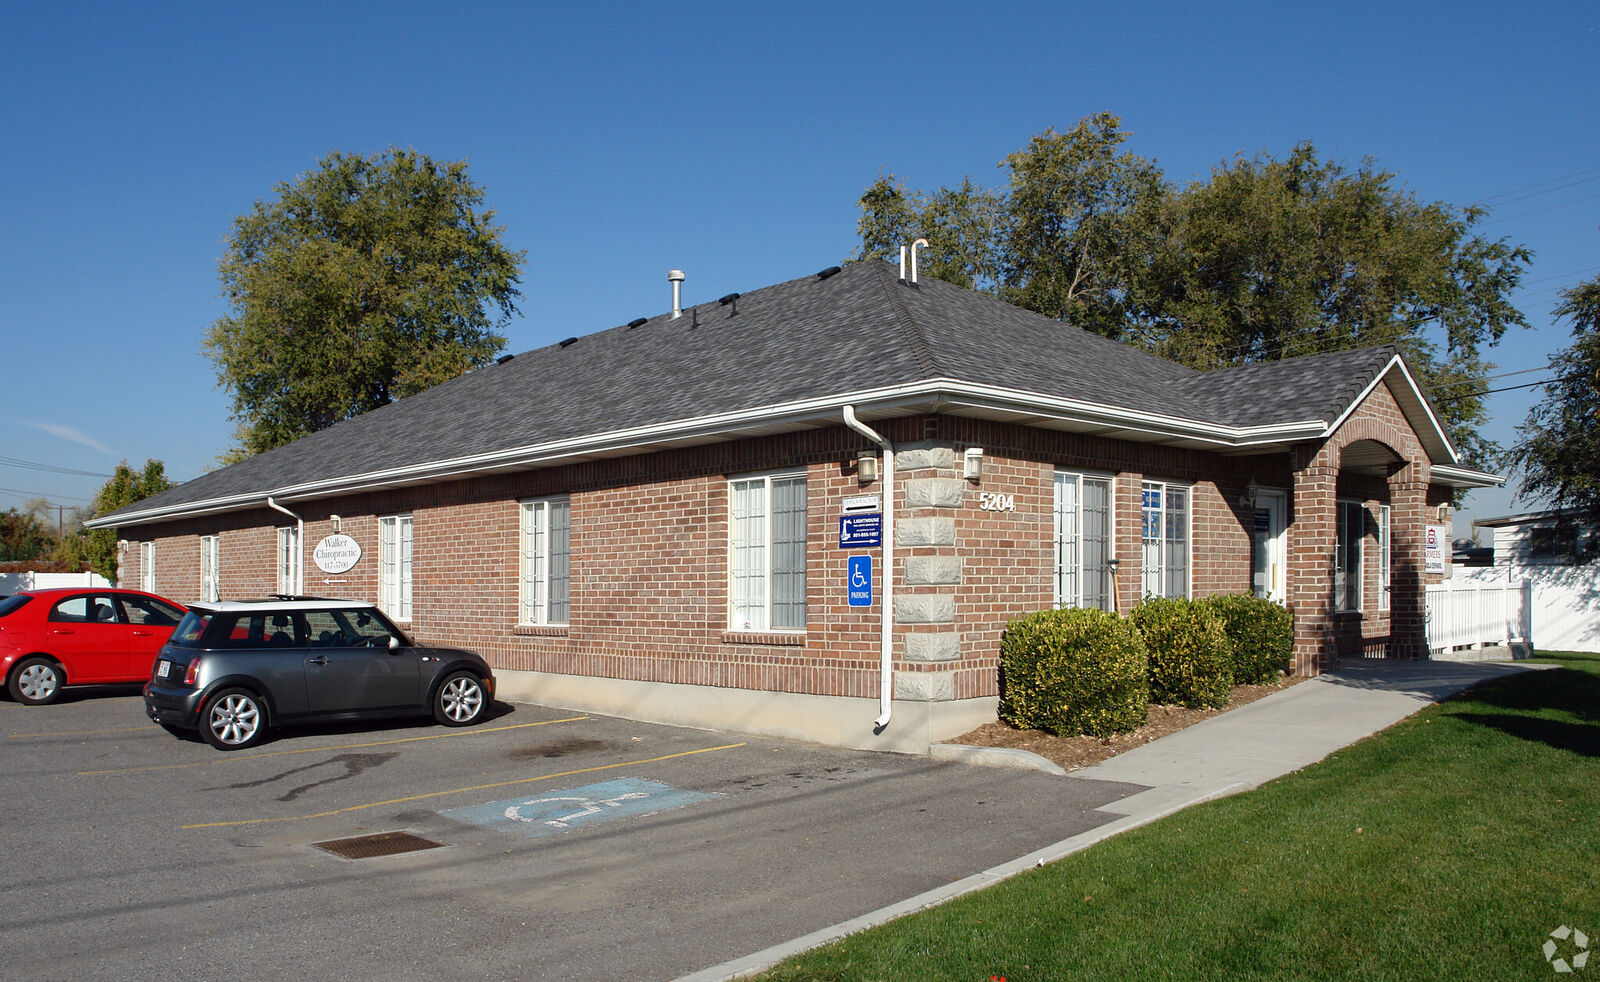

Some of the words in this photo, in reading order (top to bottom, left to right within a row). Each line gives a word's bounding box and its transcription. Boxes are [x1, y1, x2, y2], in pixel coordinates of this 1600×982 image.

[979, 492, 1015, 512] 5204
[324, 537, 347, 548] Walker
[316, 548, 357, 560] Chiropractic
[851, 591, 868, 599] PARKING
